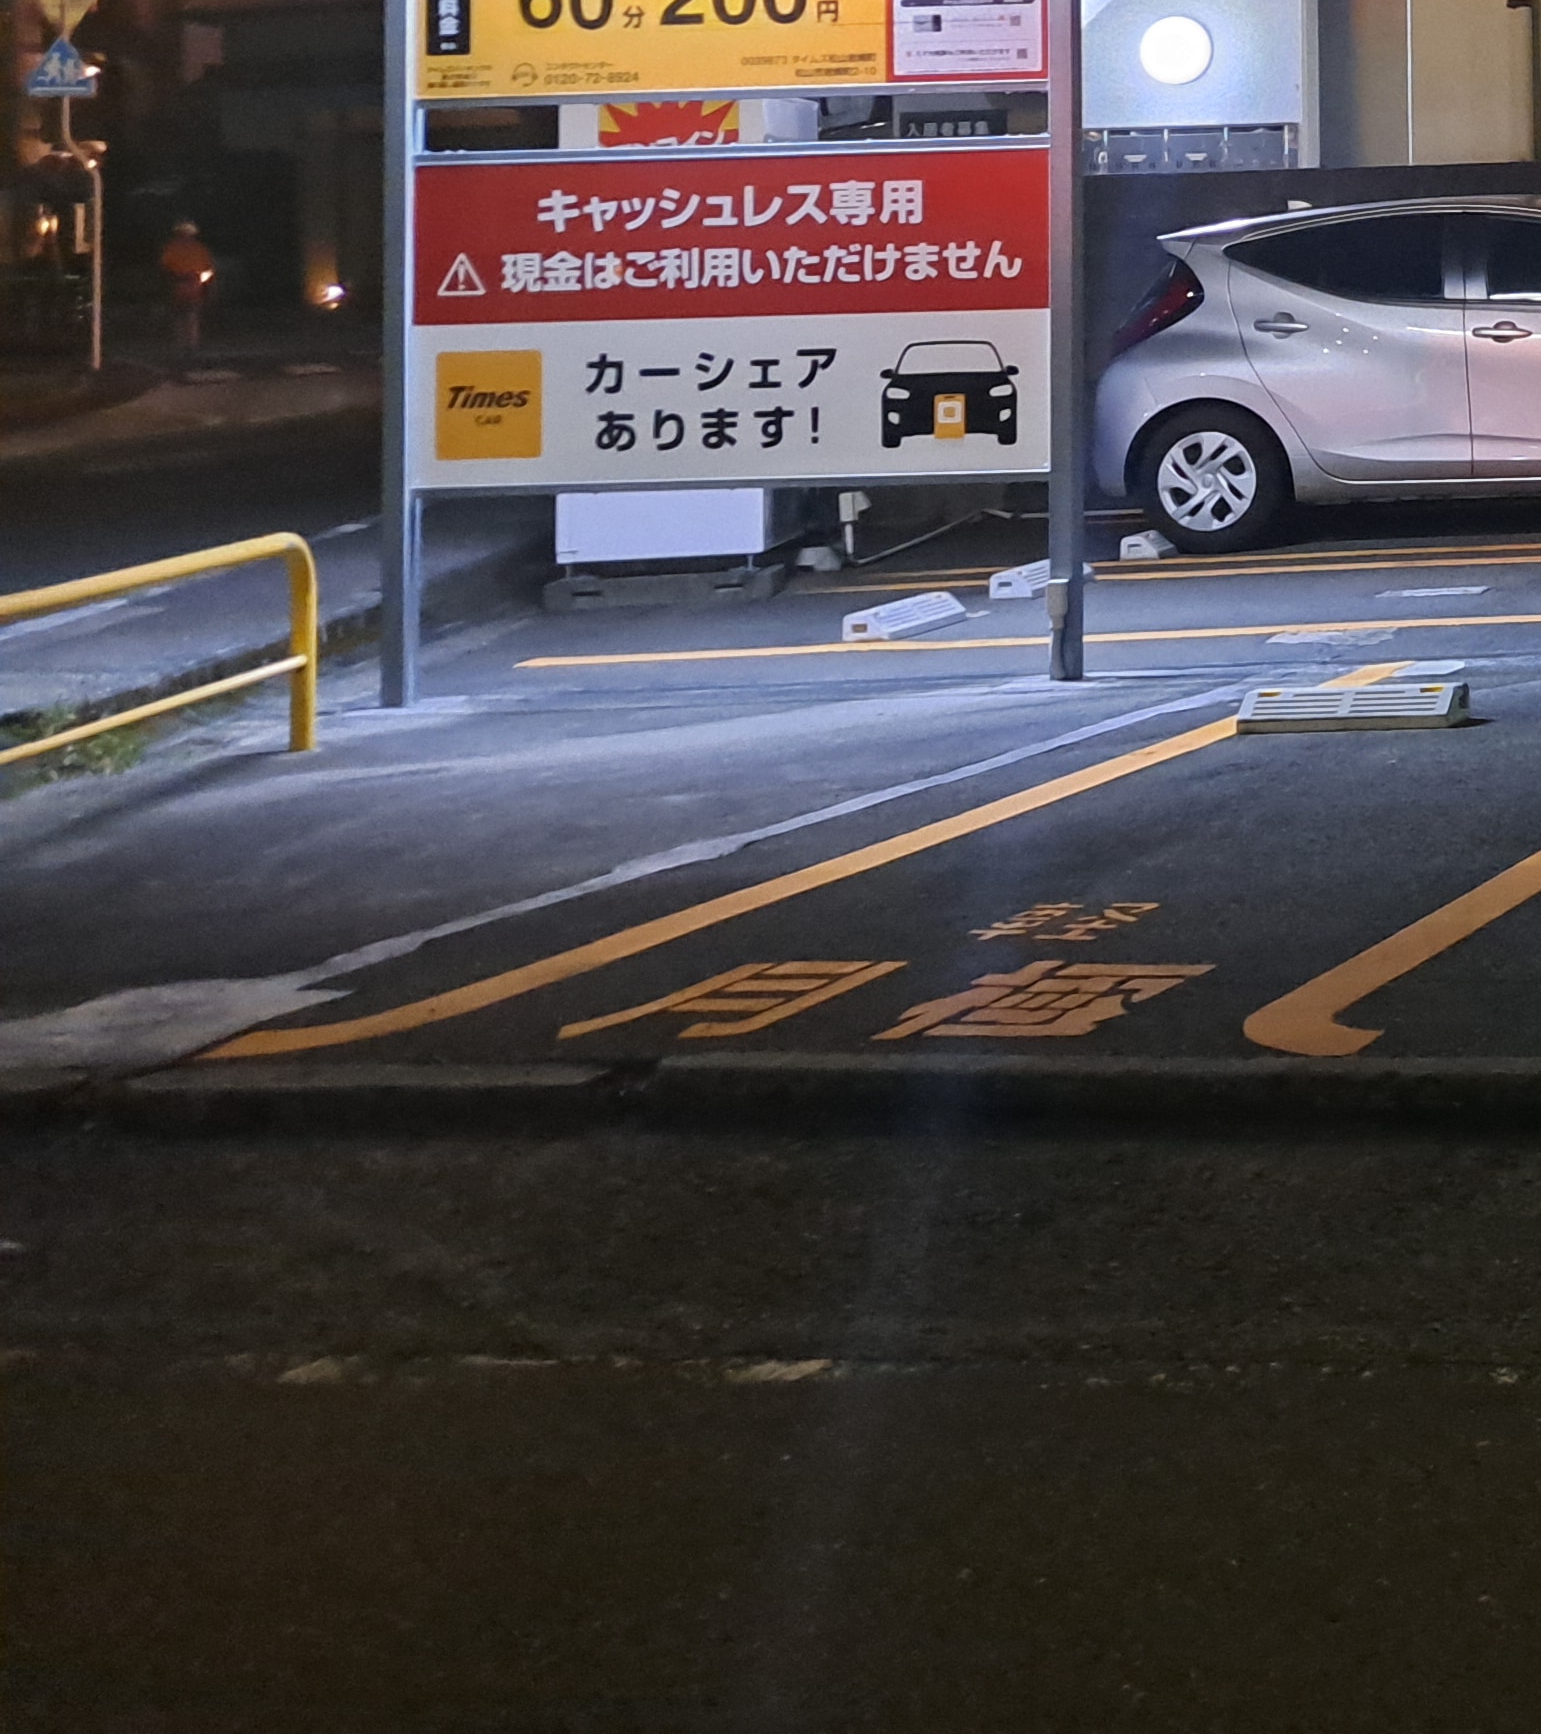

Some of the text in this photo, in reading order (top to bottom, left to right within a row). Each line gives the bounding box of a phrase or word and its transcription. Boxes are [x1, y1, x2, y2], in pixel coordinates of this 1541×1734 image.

[536, 179, 924, 235] キャッシュレス専用
[500, 239, 1023, 293] 現金はご利用いただけません
[446, 385, 530, 410] Times
[584, 347, 837, 395] カーシェア
[556, 958, 1216, 1040] 月極
